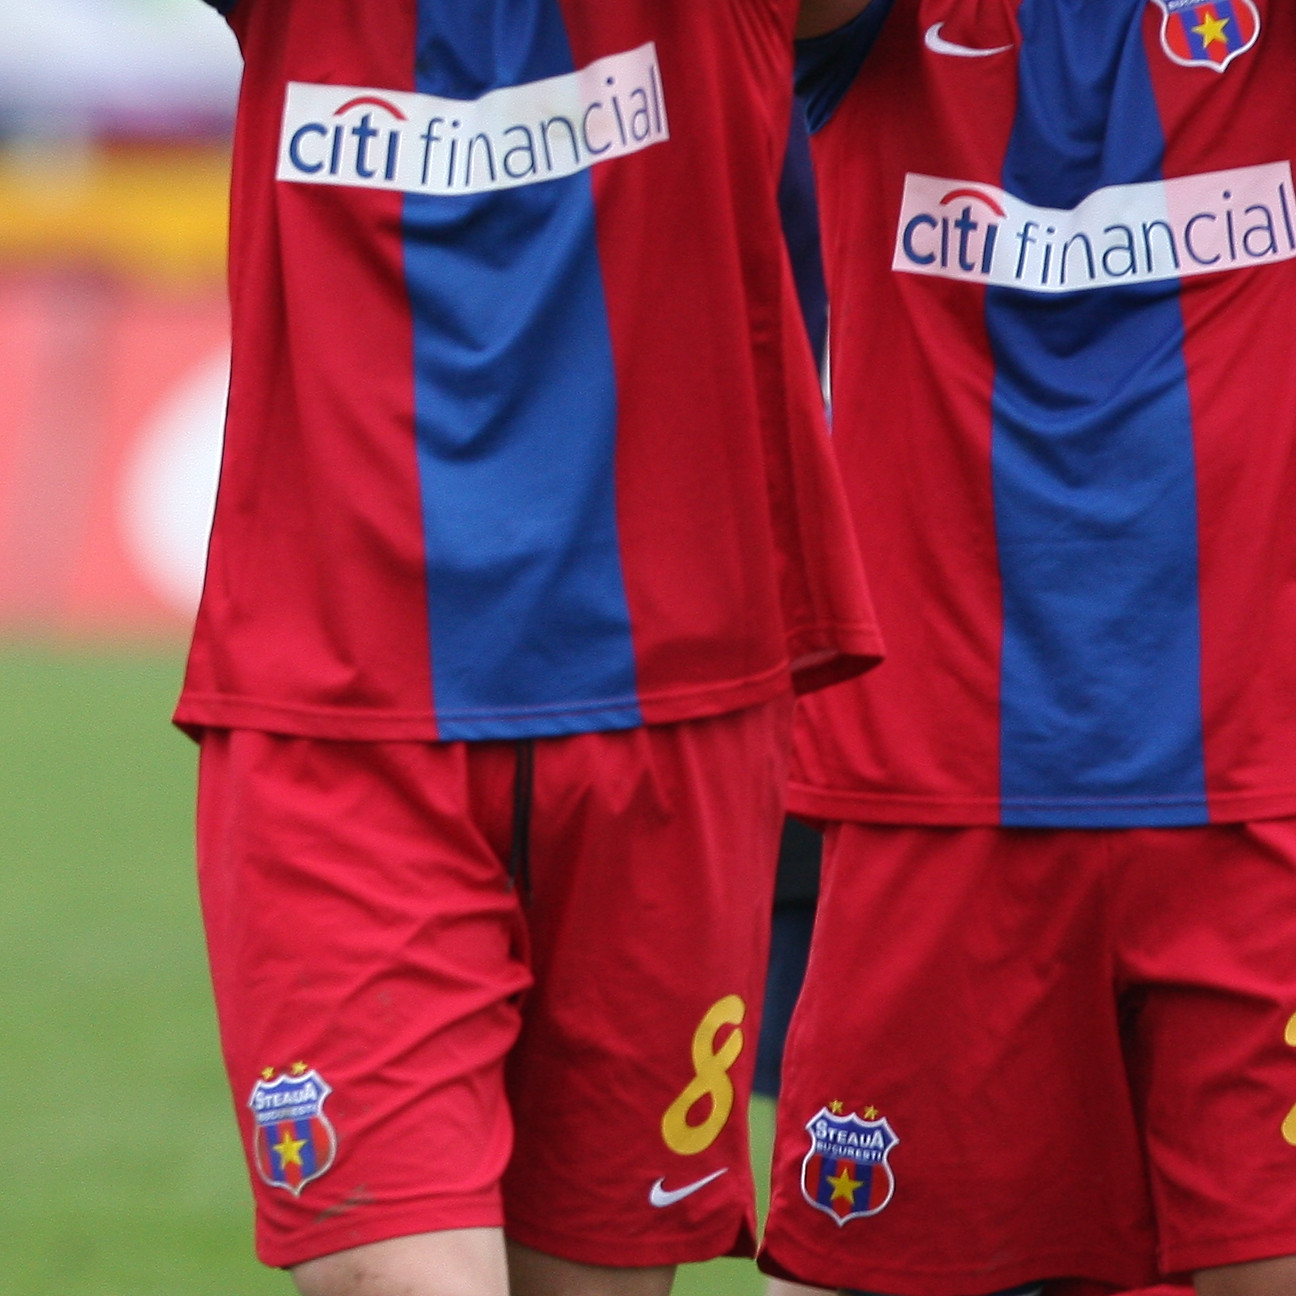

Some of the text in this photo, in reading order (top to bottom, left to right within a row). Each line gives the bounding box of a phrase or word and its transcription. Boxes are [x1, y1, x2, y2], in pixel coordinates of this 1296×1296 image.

[420, 64, 664, 187] financial
[1016, 182, 1296, 284] financial
[661, 994, 746, 1156] 8
[816, 1119, 885, 1149] STEAUA
